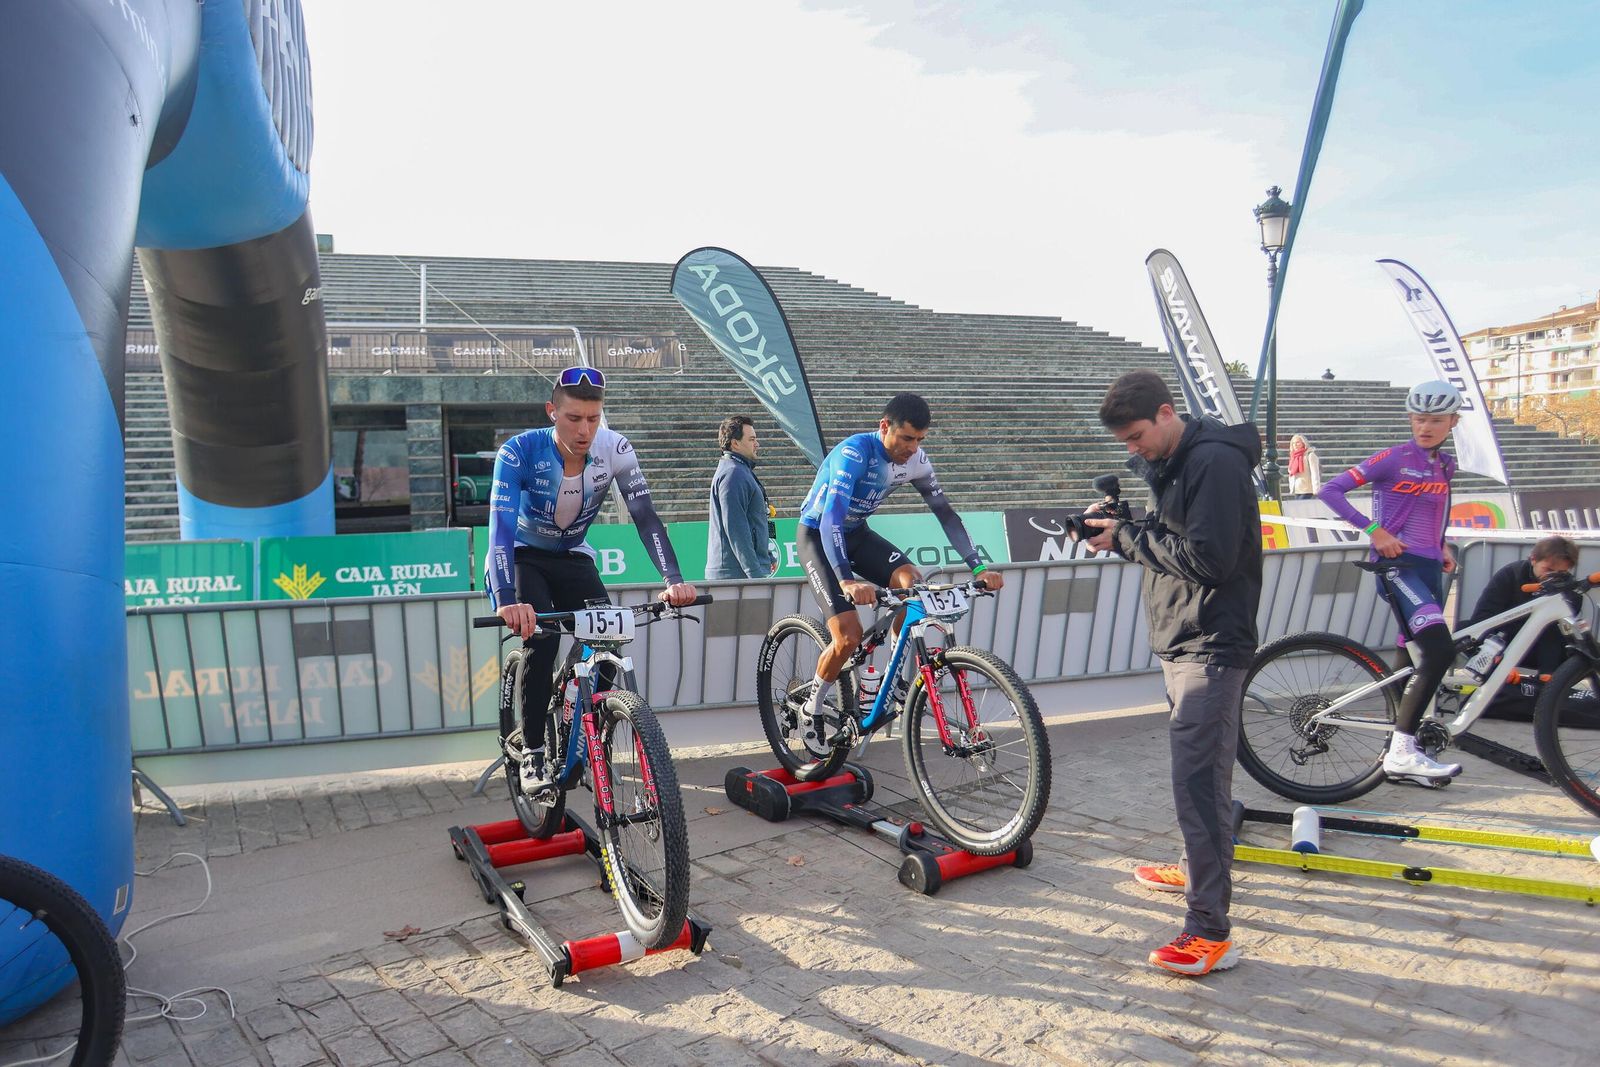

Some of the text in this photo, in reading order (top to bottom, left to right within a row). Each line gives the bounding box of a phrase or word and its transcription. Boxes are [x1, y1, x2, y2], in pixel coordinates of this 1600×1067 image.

[371, 346, 427, 356] GARMIN
[453, 346, 507, 356] GARMIN
[608, 345, 656, 357] GARMIN
[1530, 508, 1600, 531] GOBI
[652, 532, 668, 572] MERIDA
[335, 562, 458, 583] CAJA RURAL
[125, 575, 241, 596] AJA RURAL
[926, 590, 961, 611] 15-2
[585, 611, 624, 635] 15-1
[764, 639, 779, 672] TABROS
[503, 673, 514, 709] TABROS
[589, 733, 612, 805] MANITOU
